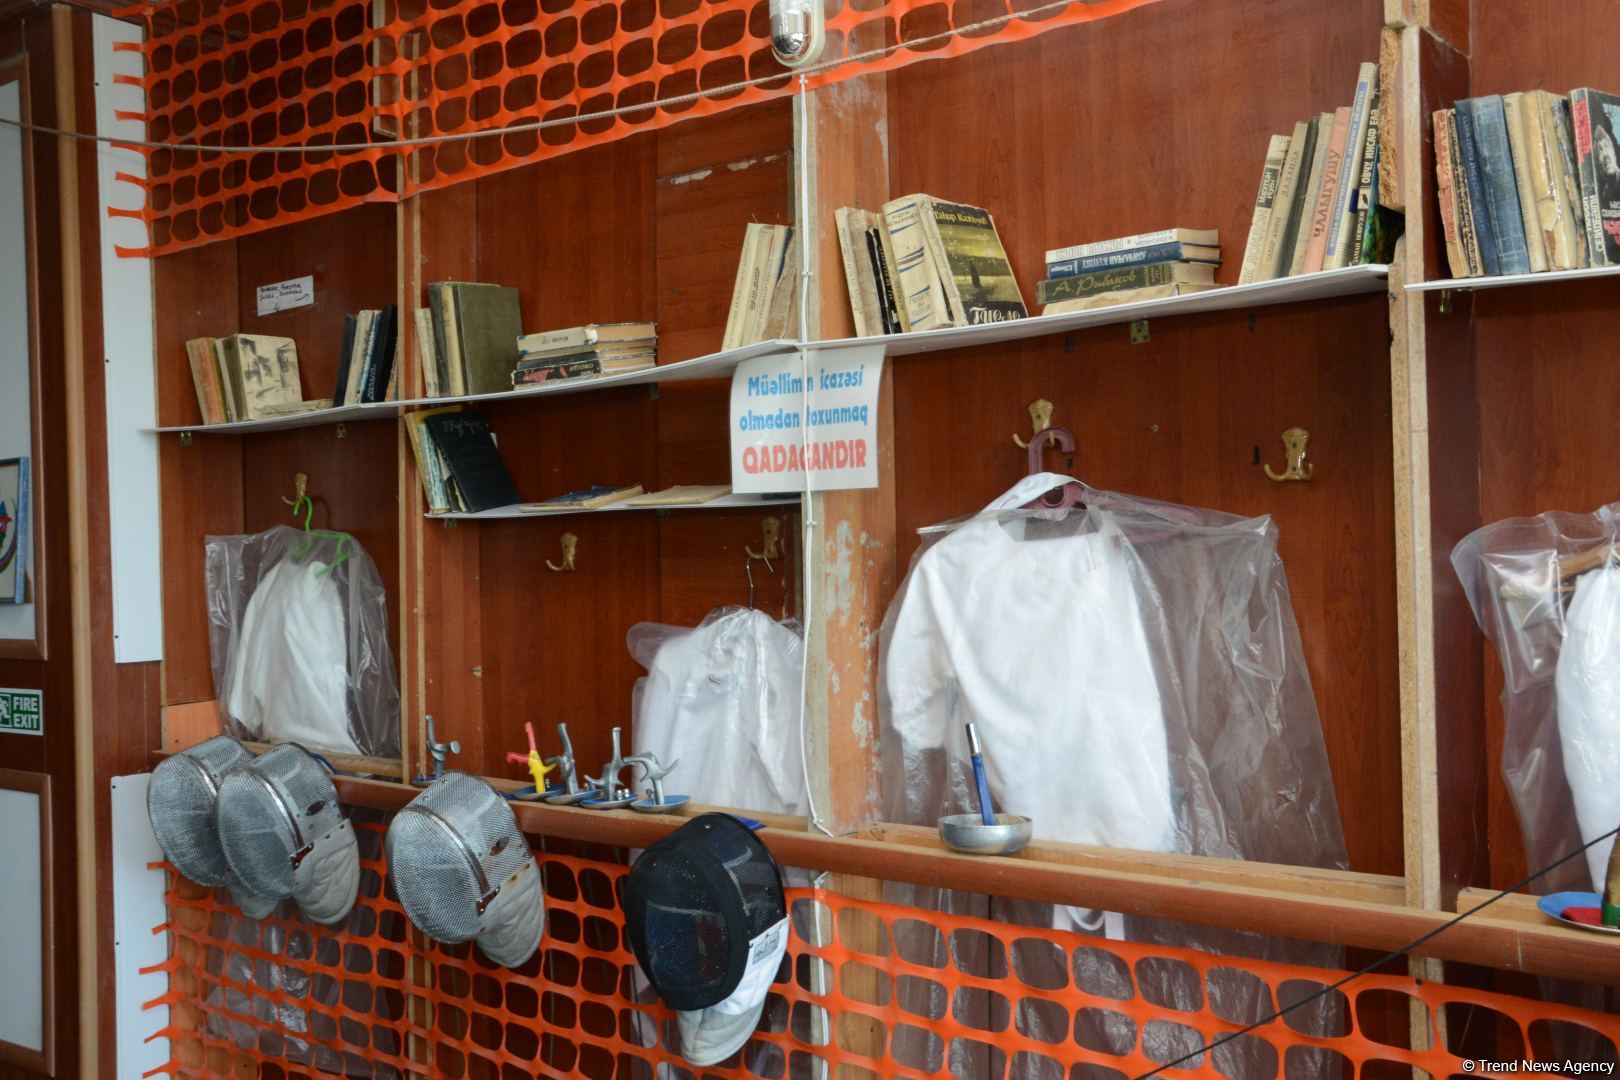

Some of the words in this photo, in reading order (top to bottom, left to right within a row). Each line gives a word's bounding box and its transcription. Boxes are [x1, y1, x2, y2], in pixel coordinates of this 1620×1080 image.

[747, 373, 814, 397] Müəllimn
[820, 364, 865, 391] icazəsi
[13, 696, 38, 711] FIRE
[13, 713, 39, 729] EXIT
